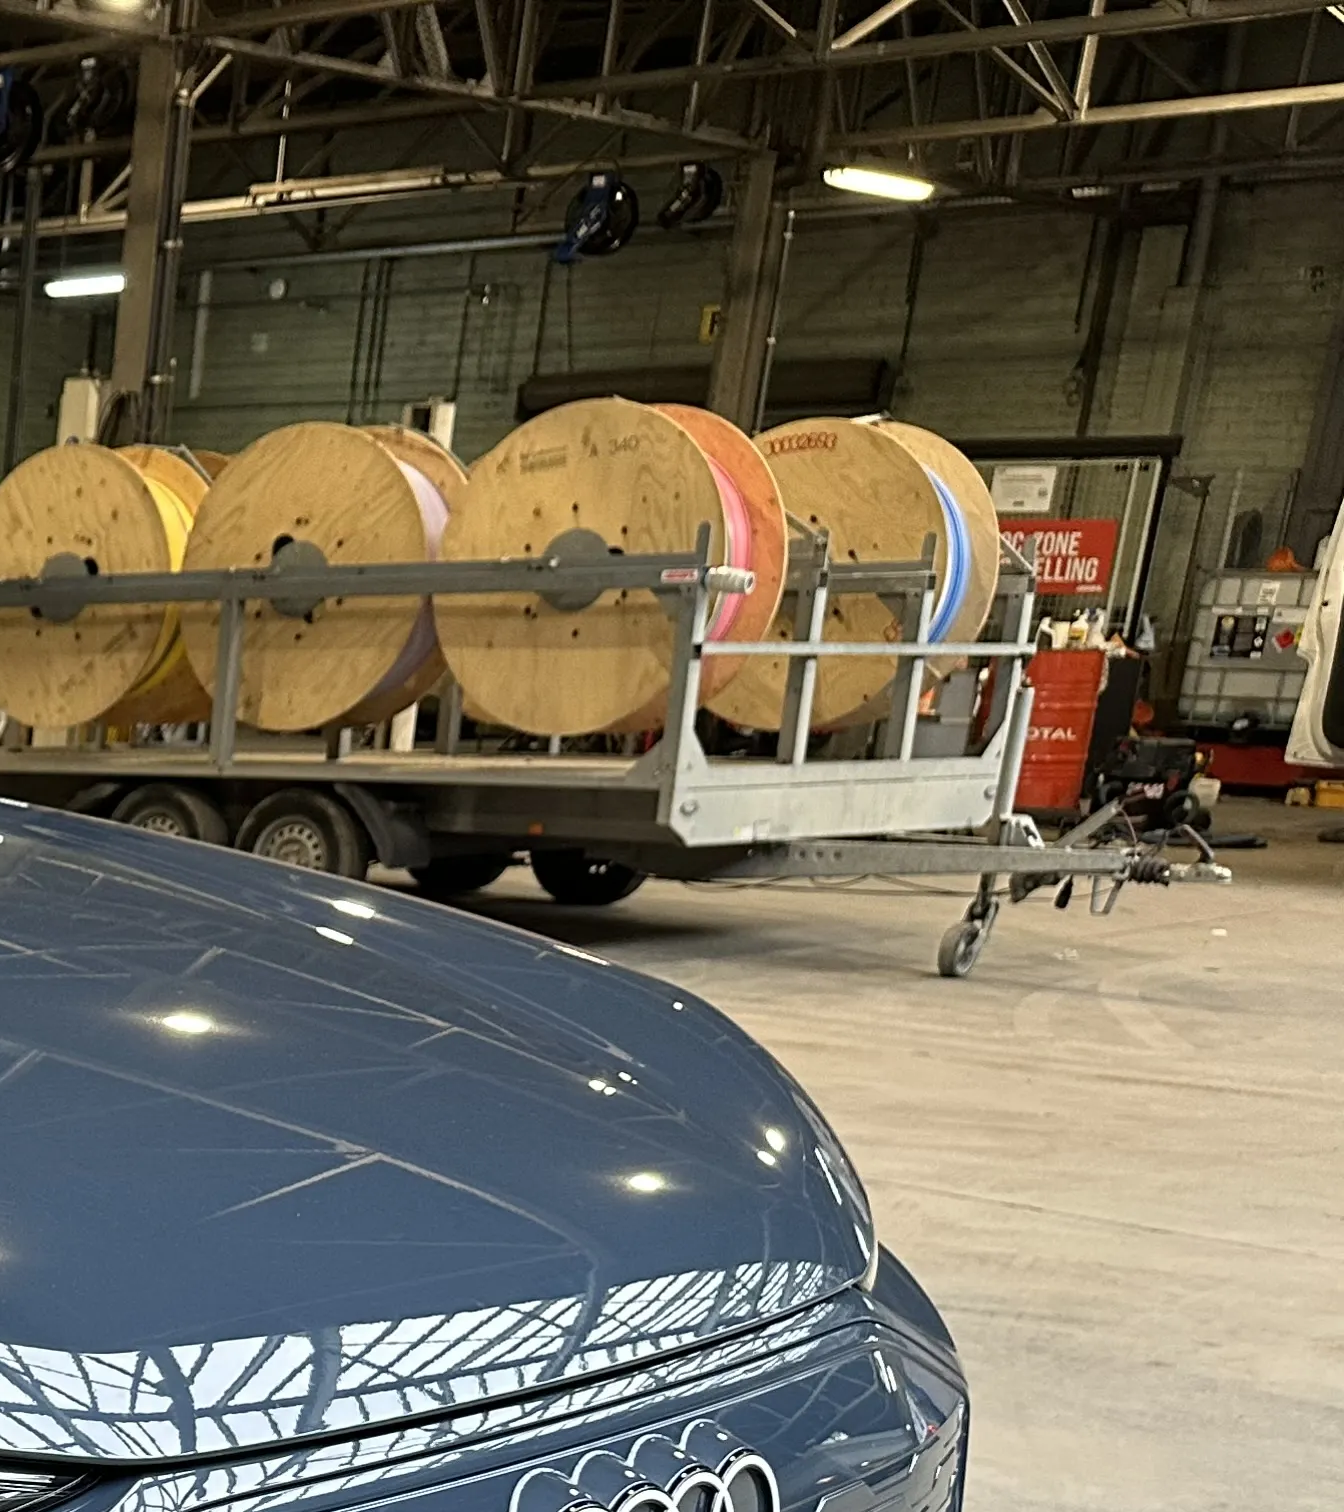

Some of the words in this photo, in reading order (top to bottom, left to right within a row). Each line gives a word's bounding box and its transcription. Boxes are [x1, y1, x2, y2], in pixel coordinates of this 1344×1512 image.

[1032, 530, 1083, 557] ZONE
[1032, 556, 1100, 583] ELLING
[1027, 726, 1077, 741] OTAL
